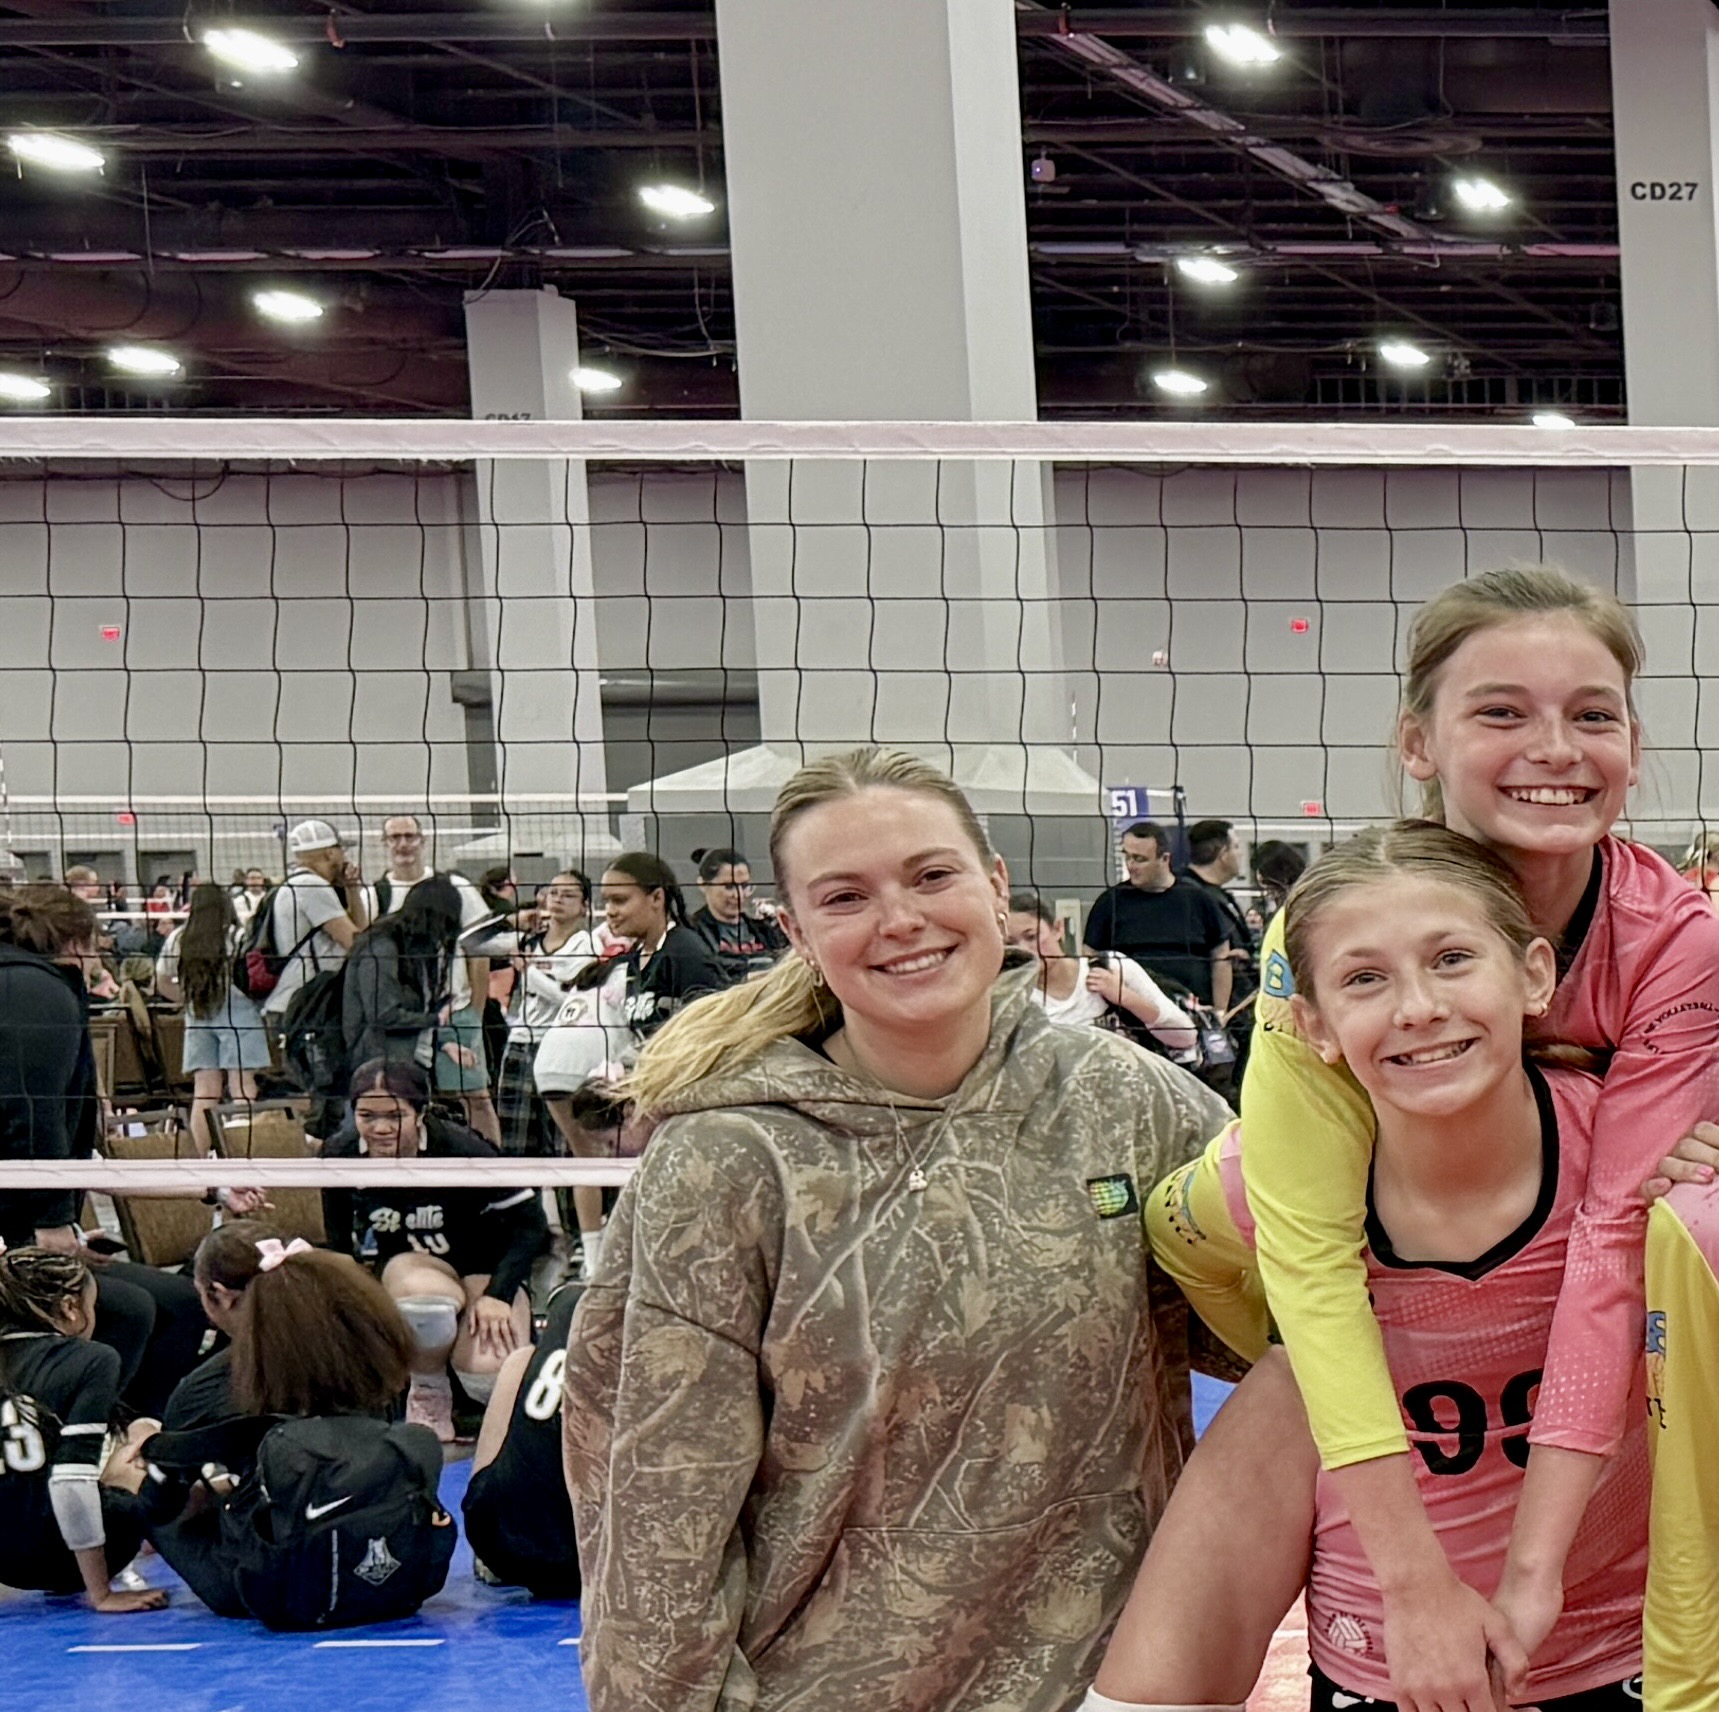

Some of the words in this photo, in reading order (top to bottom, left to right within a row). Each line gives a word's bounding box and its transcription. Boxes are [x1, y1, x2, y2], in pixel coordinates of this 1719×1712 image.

[1630, 182, 1698, 201] CD27
[1111, 788, 1138, 817] 51
[525, 1348, 567, 1420] 8
